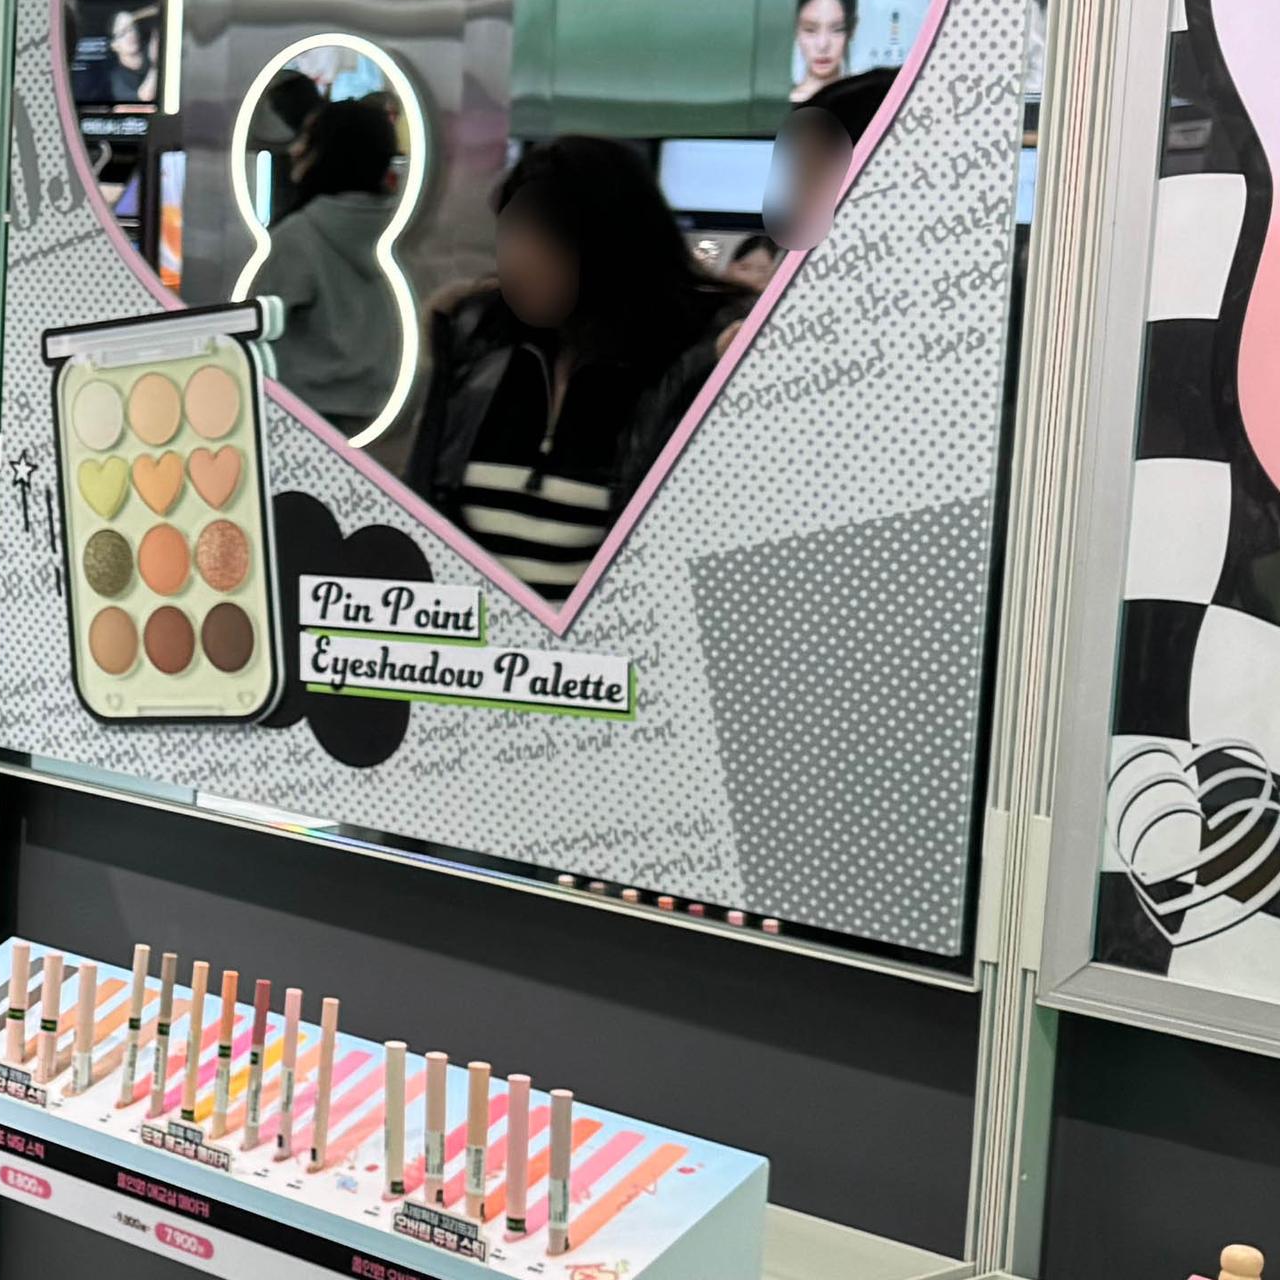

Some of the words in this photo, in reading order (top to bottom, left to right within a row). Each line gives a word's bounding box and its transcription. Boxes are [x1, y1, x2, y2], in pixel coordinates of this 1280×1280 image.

[312, 581, 373, 623] Pin
[382, 585, 475, 632] Point
[311, 635, 483, 691] Eyeshadow
[493, 651, 623, 703] Palette
